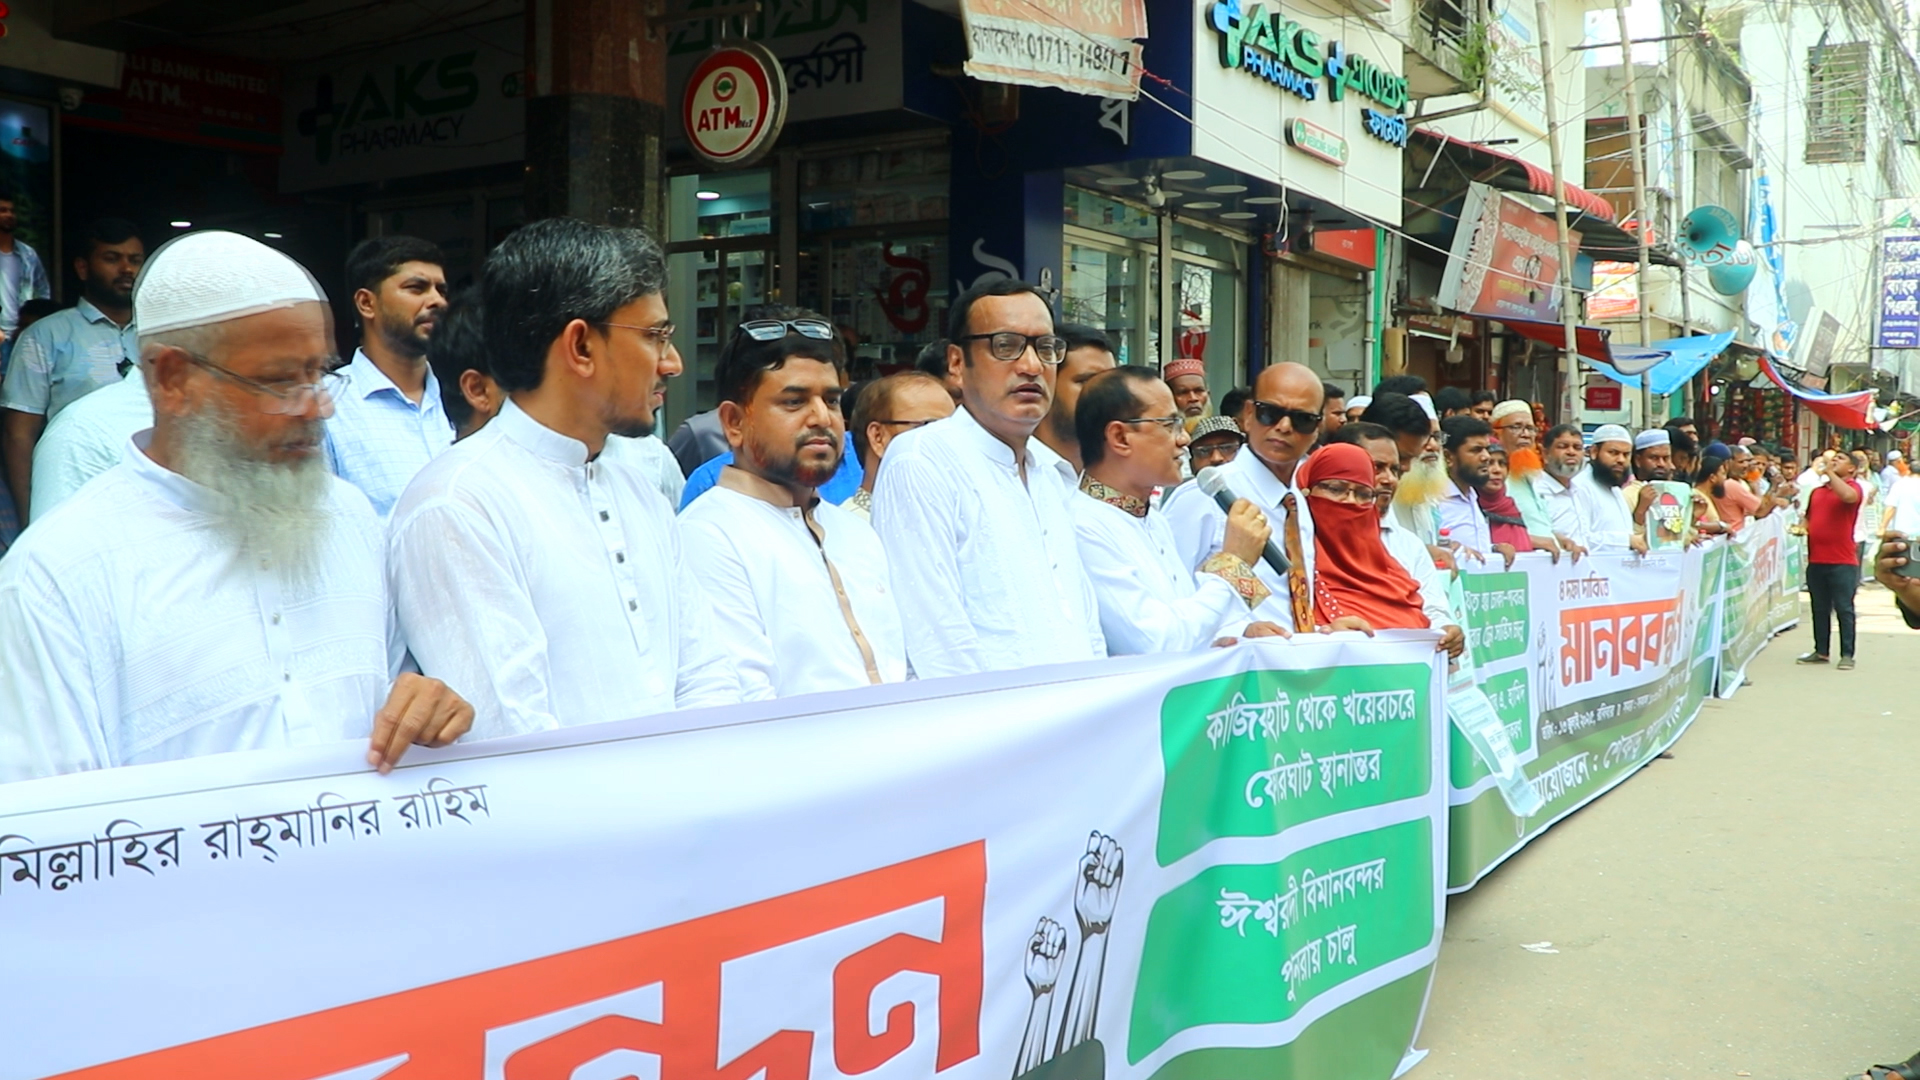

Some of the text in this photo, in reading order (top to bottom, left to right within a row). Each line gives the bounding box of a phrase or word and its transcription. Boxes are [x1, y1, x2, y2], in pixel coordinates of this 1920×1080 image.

[1242, 3, 1323, 78] AKS
[126, 76, 182, 106] ATM
[150, 57, 200, 81] BANK
[204, 68, 268, 95] LIMITED
[344, 50, 477, 127] AKS
[1243, 45, 1320, 101] PHARMACY
[339, 114, 464, 156] PHARMACY
[697, 105, 741, 132] ATM
[1296, 693, 1337, 733] থেকে
[1317, 748, 1383, 799] স্থানান্তর
[392, 776, 491, 829] রাহিম
[1301, 857, 1386, 918] বিমানবন্দর
[1280, 924, 1358, 1002] পুনরায় চালু
